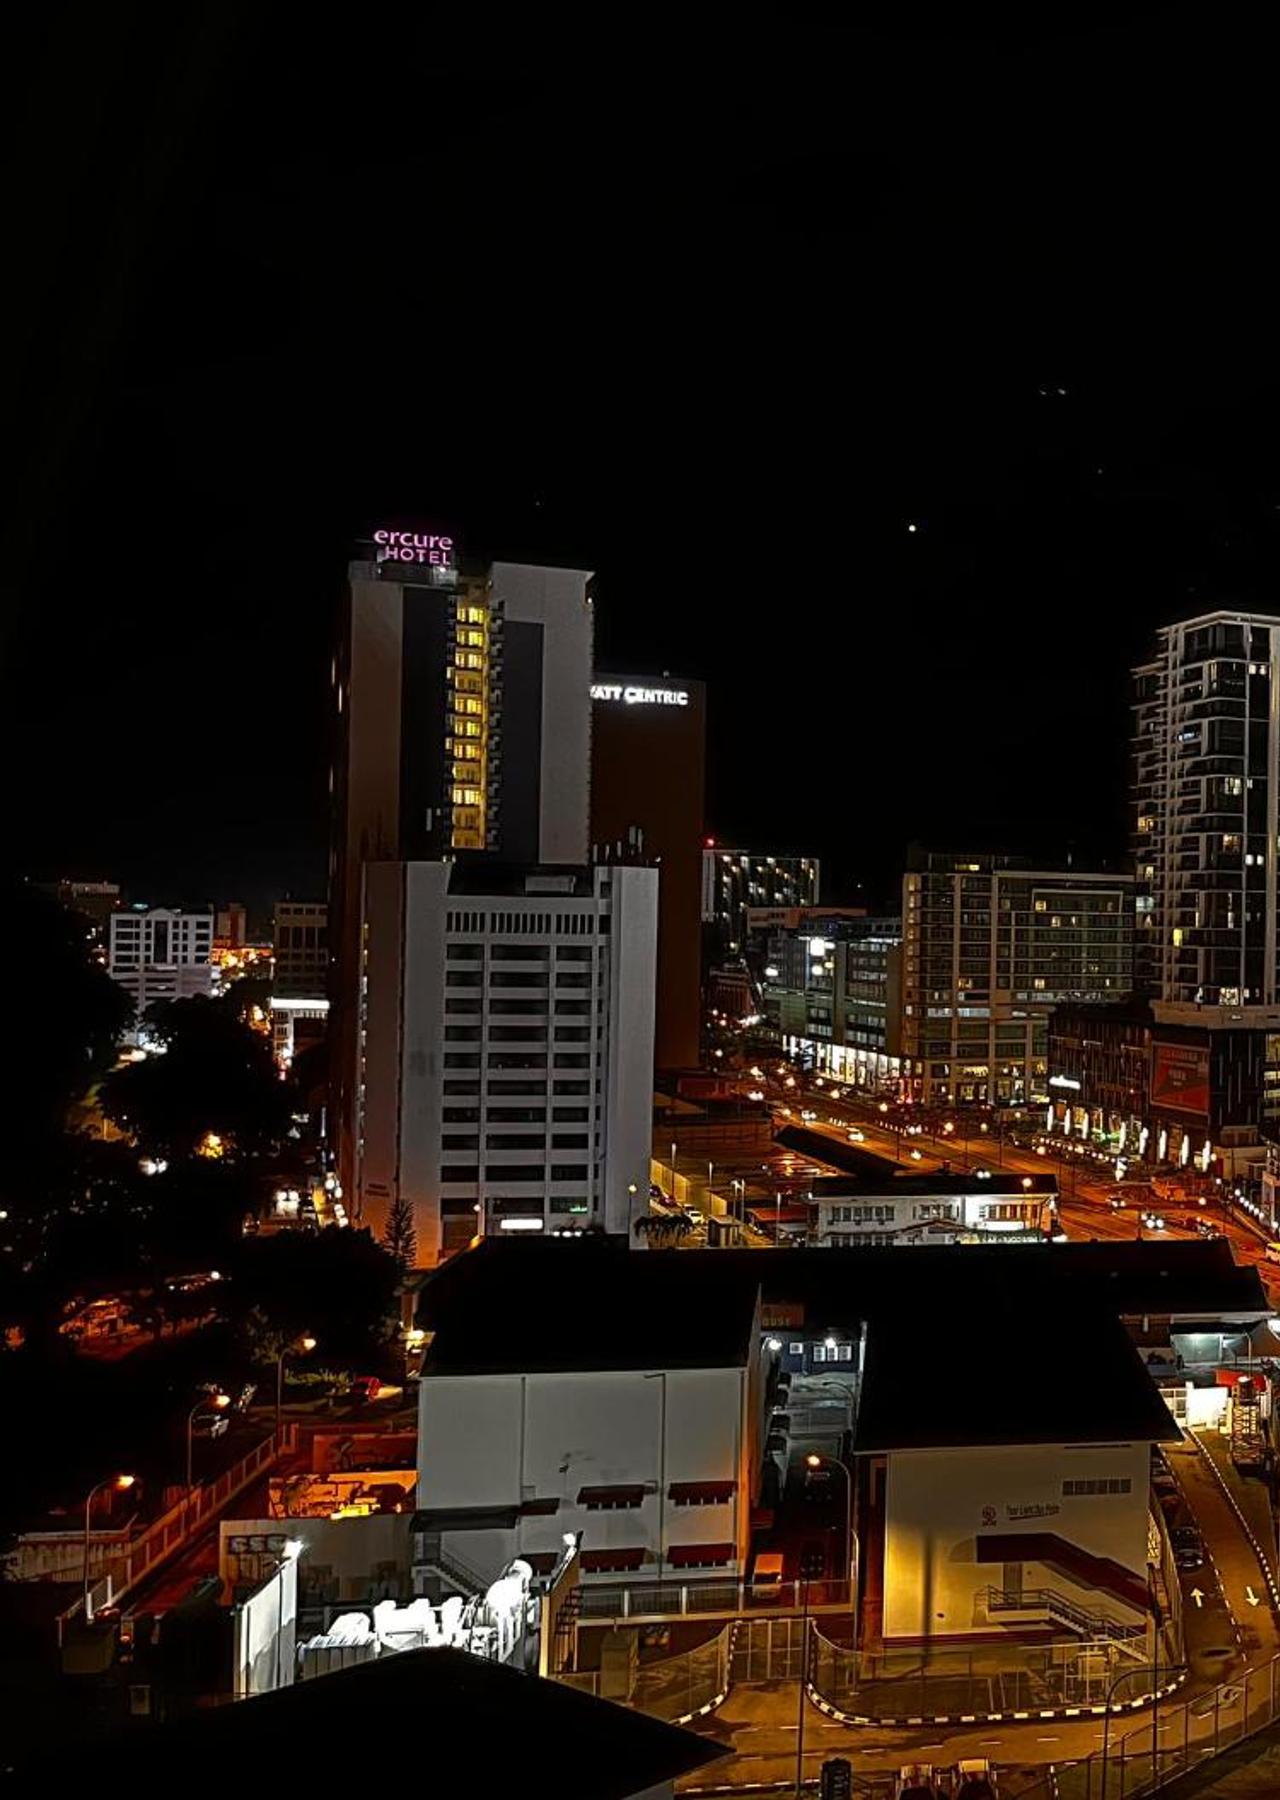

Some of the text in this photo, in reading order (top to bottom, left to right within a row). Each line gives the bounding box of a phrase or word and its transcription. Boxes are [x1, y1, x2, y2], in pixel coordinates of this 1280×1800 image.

[373, 529, 454, 551] ercure
[383, 545, 451, 566] HOTEL
[623, 686, 689, 706] CENTRIC
